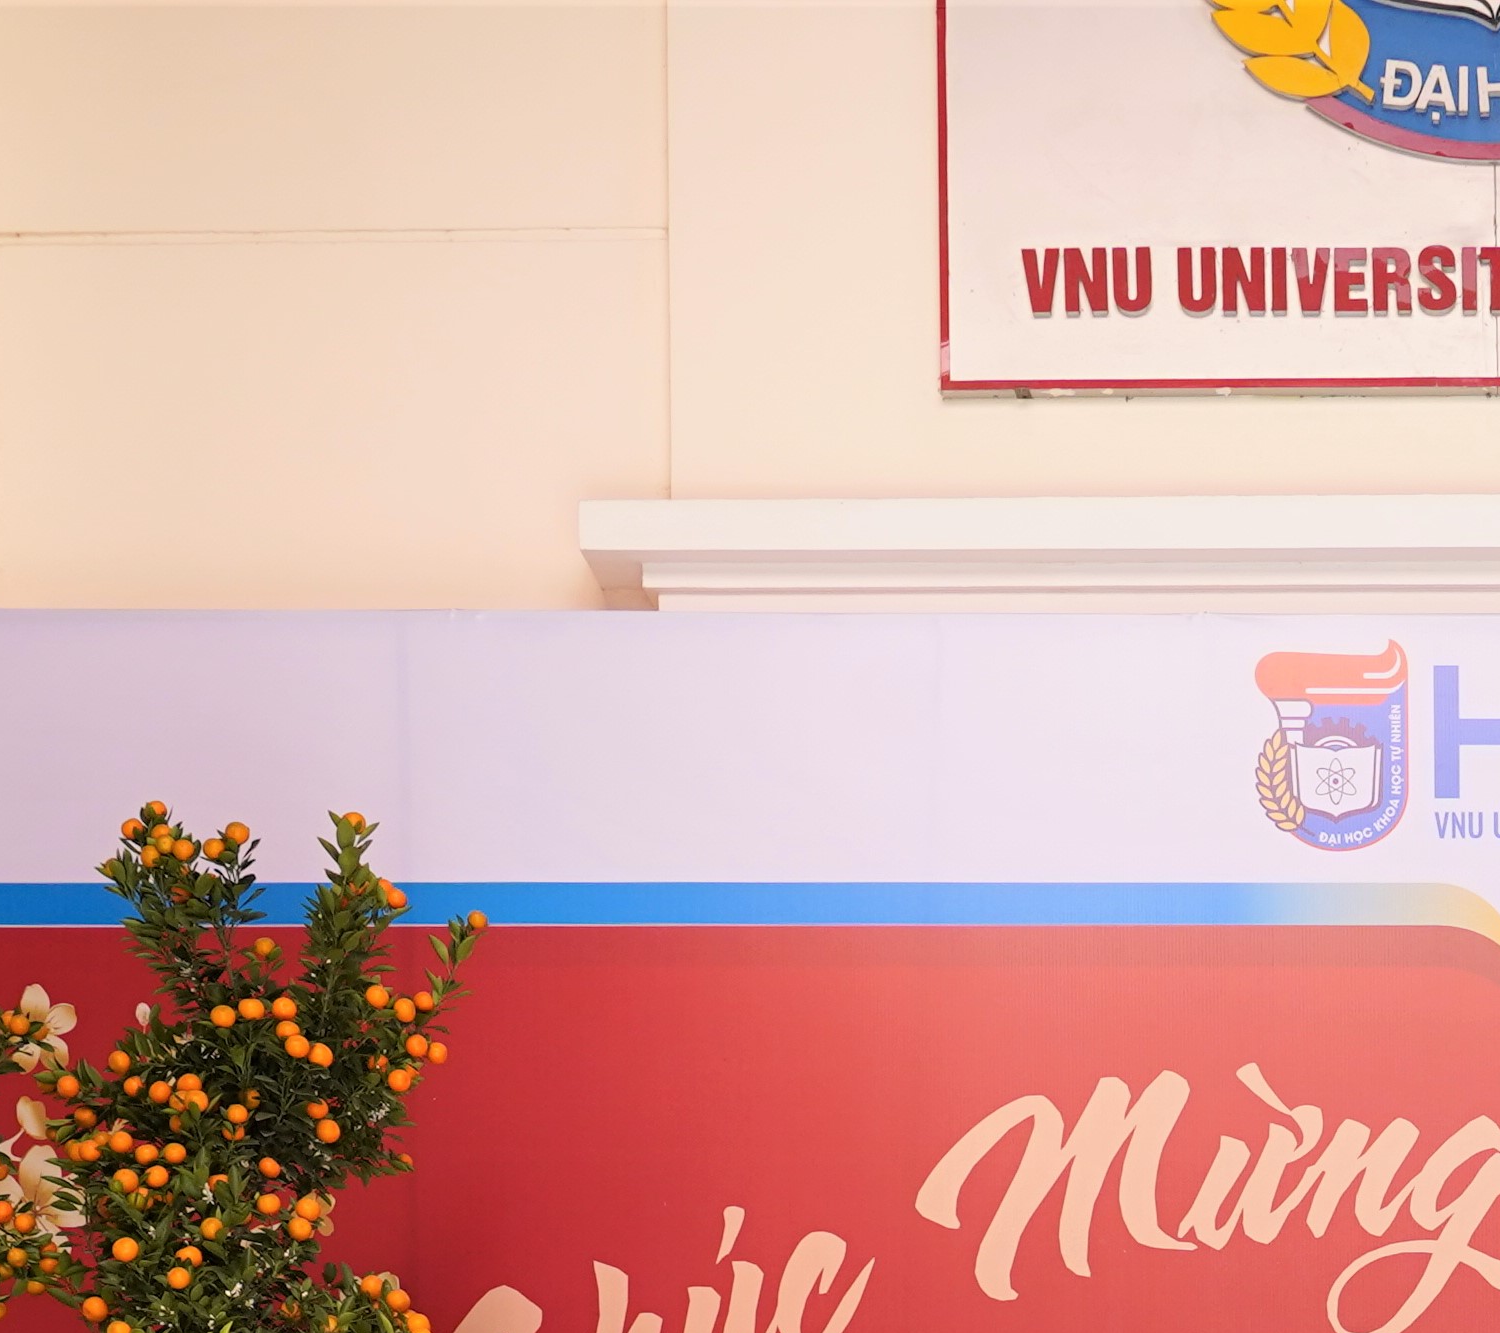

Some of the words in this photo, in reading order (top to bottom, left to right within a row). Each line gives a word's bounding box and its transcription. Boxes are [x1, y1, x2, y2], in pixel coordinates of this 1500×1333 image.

[1380, 59, 1468, 125] ĐẠI
[1021, 245, 1153, 317] VNU
[1388, 704, 1402, 743] NHIÊN
[1390, 764, 1405, 795] HỌC
[1372, 799, 1400, 832] KHOA
[1434, 811, 1484, 839] VNU
[1319, 831, 1342, 846] ĐẠI
[1345, 827, 1374, 844] HỌC
